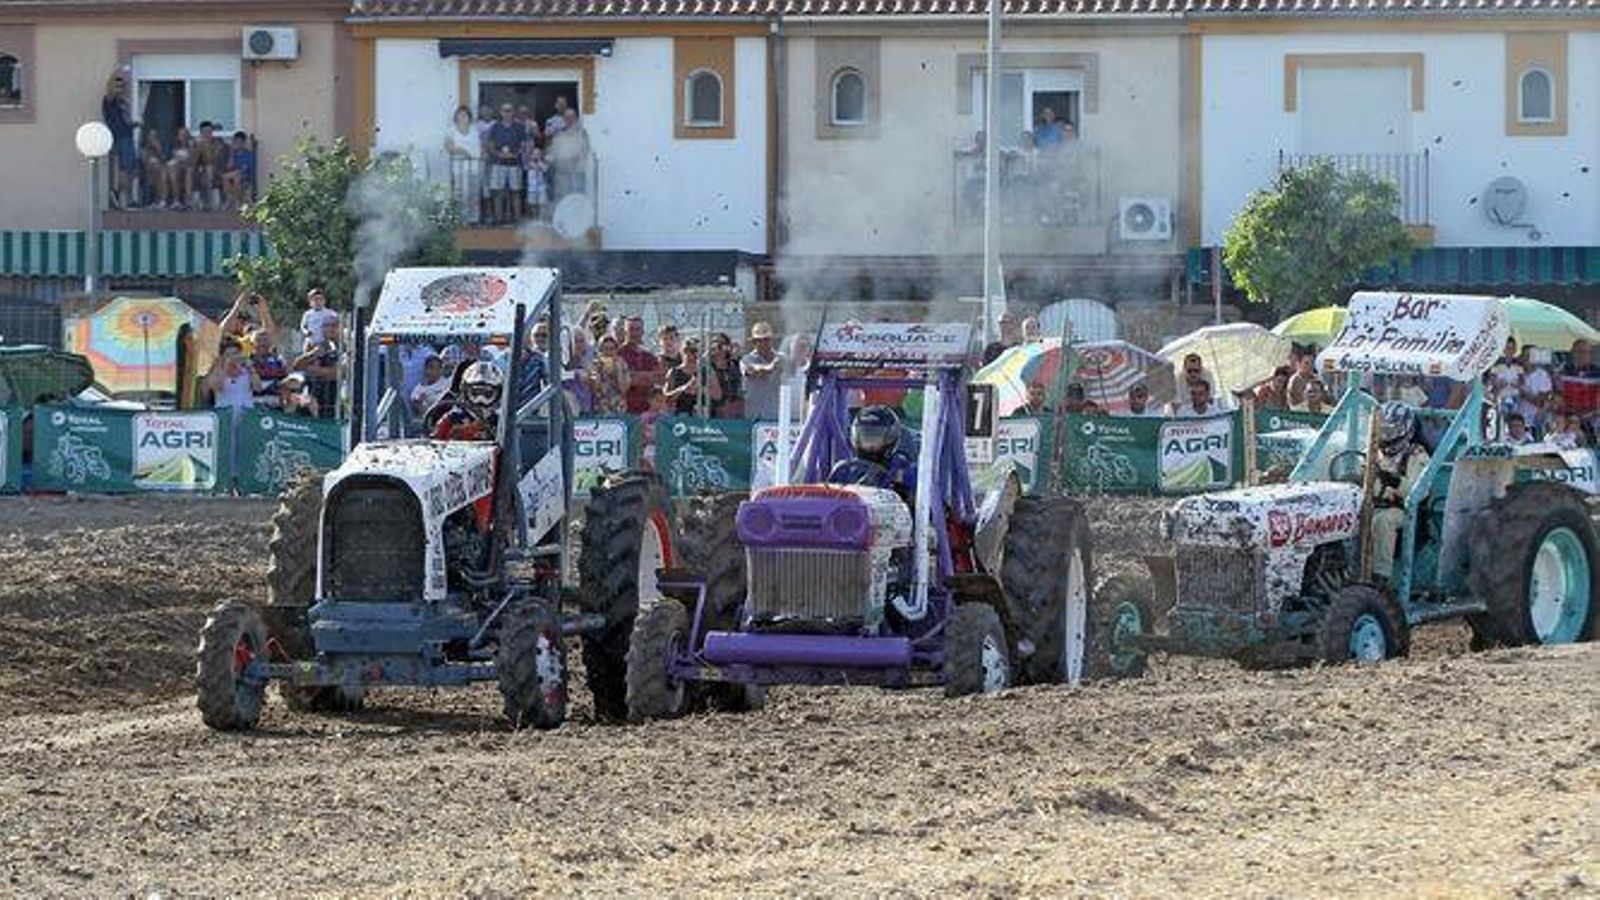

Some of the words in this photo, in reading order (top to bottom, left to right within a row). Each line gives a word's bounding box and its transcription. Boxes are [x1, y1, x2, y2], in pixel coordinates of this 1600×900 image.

[1393, 293, 1440, 321] Bar
[144, 418, 187, 429] TOTAL
[139, 430, 213, 449] AGRI
[574, 440, 622, 456] GRI
[997, 437, 1034, 455] GRI
[1164, 434, 1229, 455] AGRI
